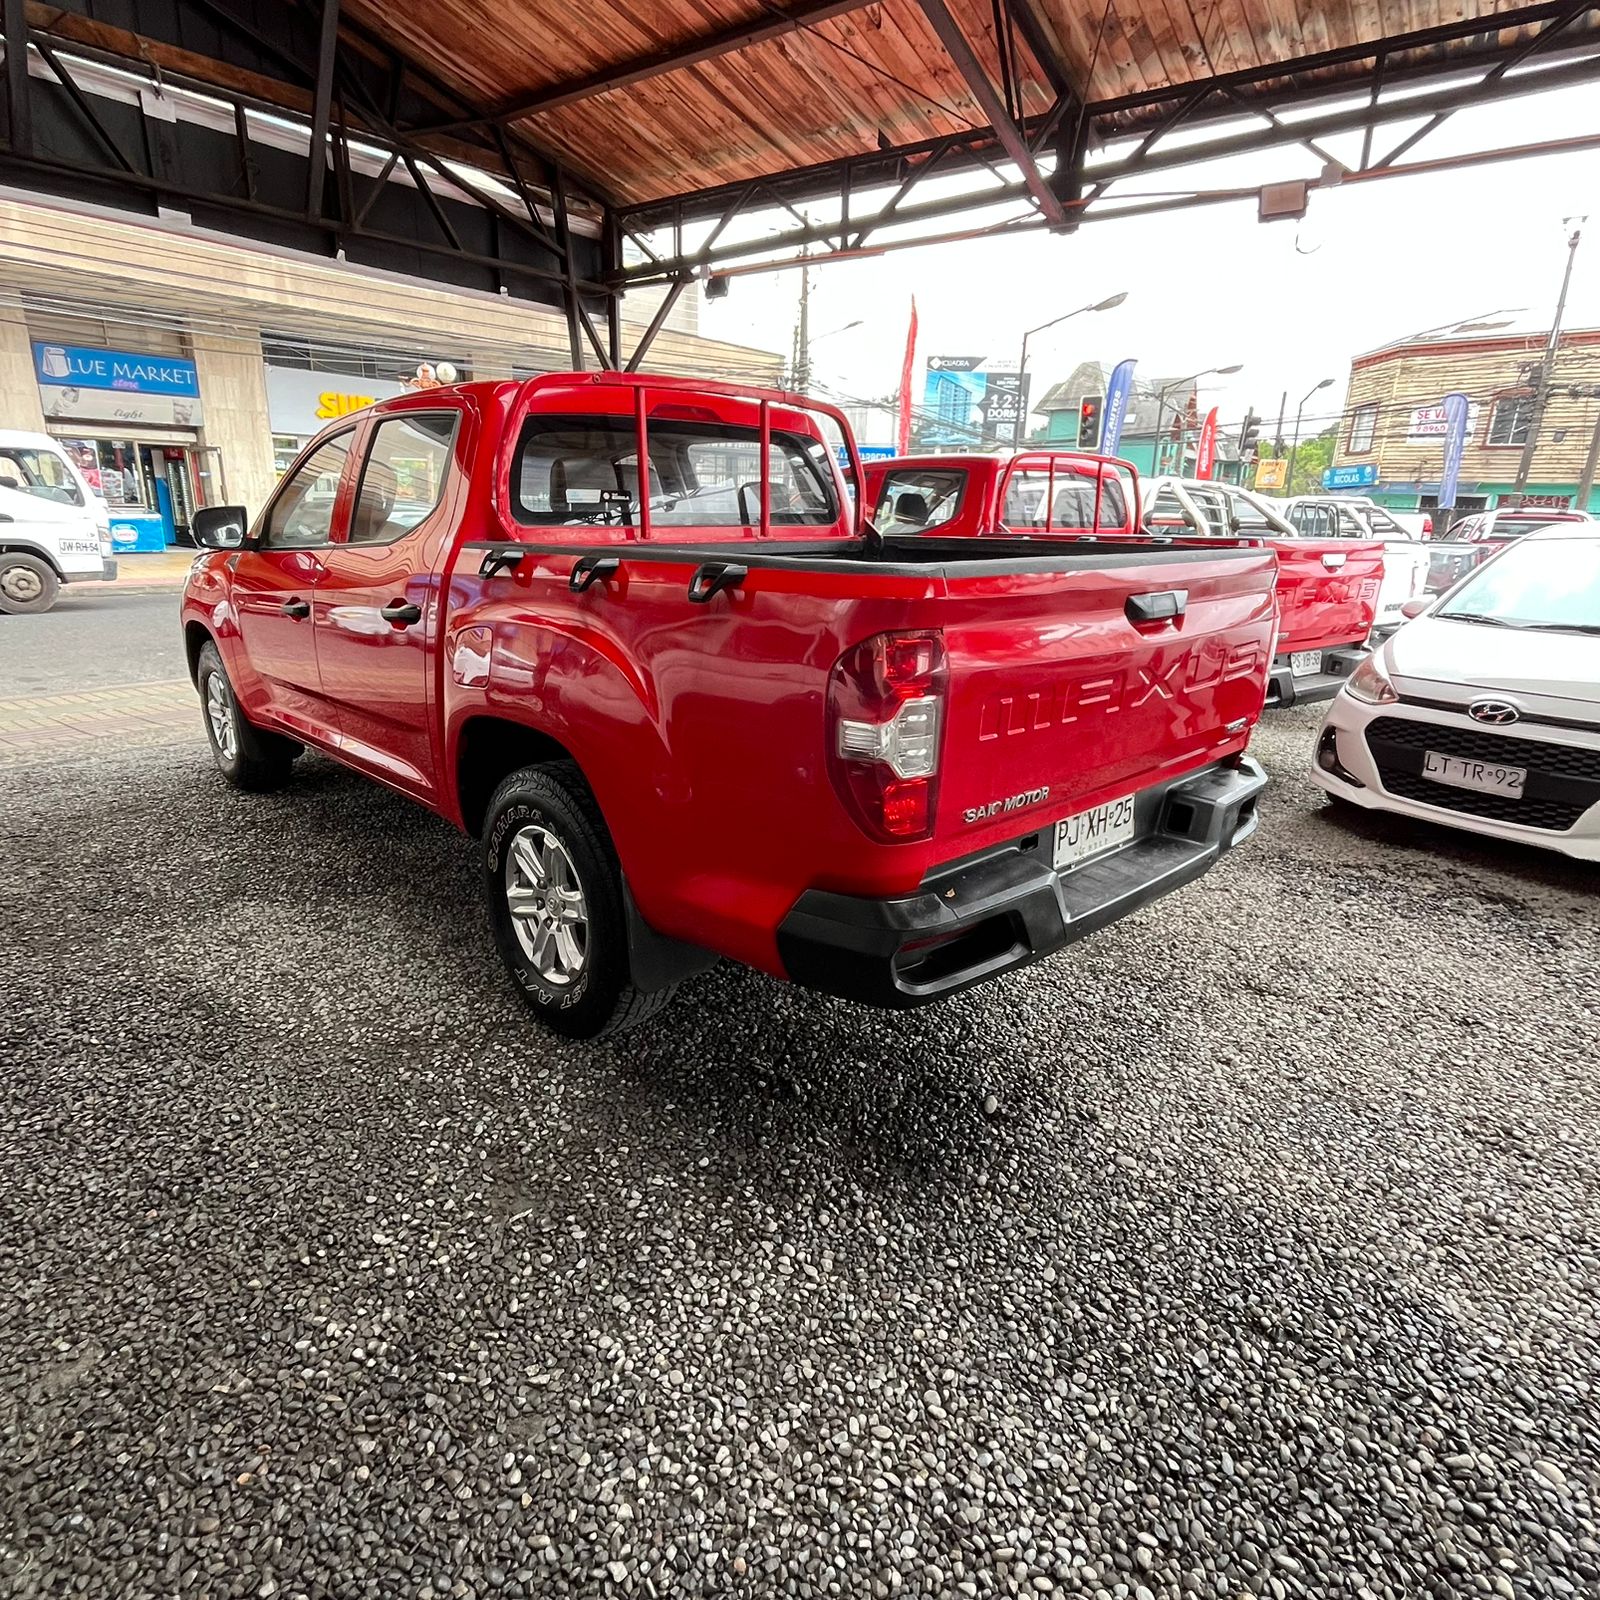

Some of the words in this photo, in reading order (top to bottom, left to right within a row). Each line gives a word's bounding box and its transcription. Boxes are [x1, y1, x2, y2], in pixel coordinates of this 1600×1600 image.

[113, 362, 195, 385] MARKET
[1108, 390, 1122, 428] AUTOS
[1417, 409, 1430, 419] SE
[1334, 474, 1360, 484] NICOLAS
[978, 640, 1261, 741] MAXUS
[964, 800, 1002, 823] SAIC
[1004, 786, 1050, 812] MOTOR
[487, 805, 545, 873] SAHARA
